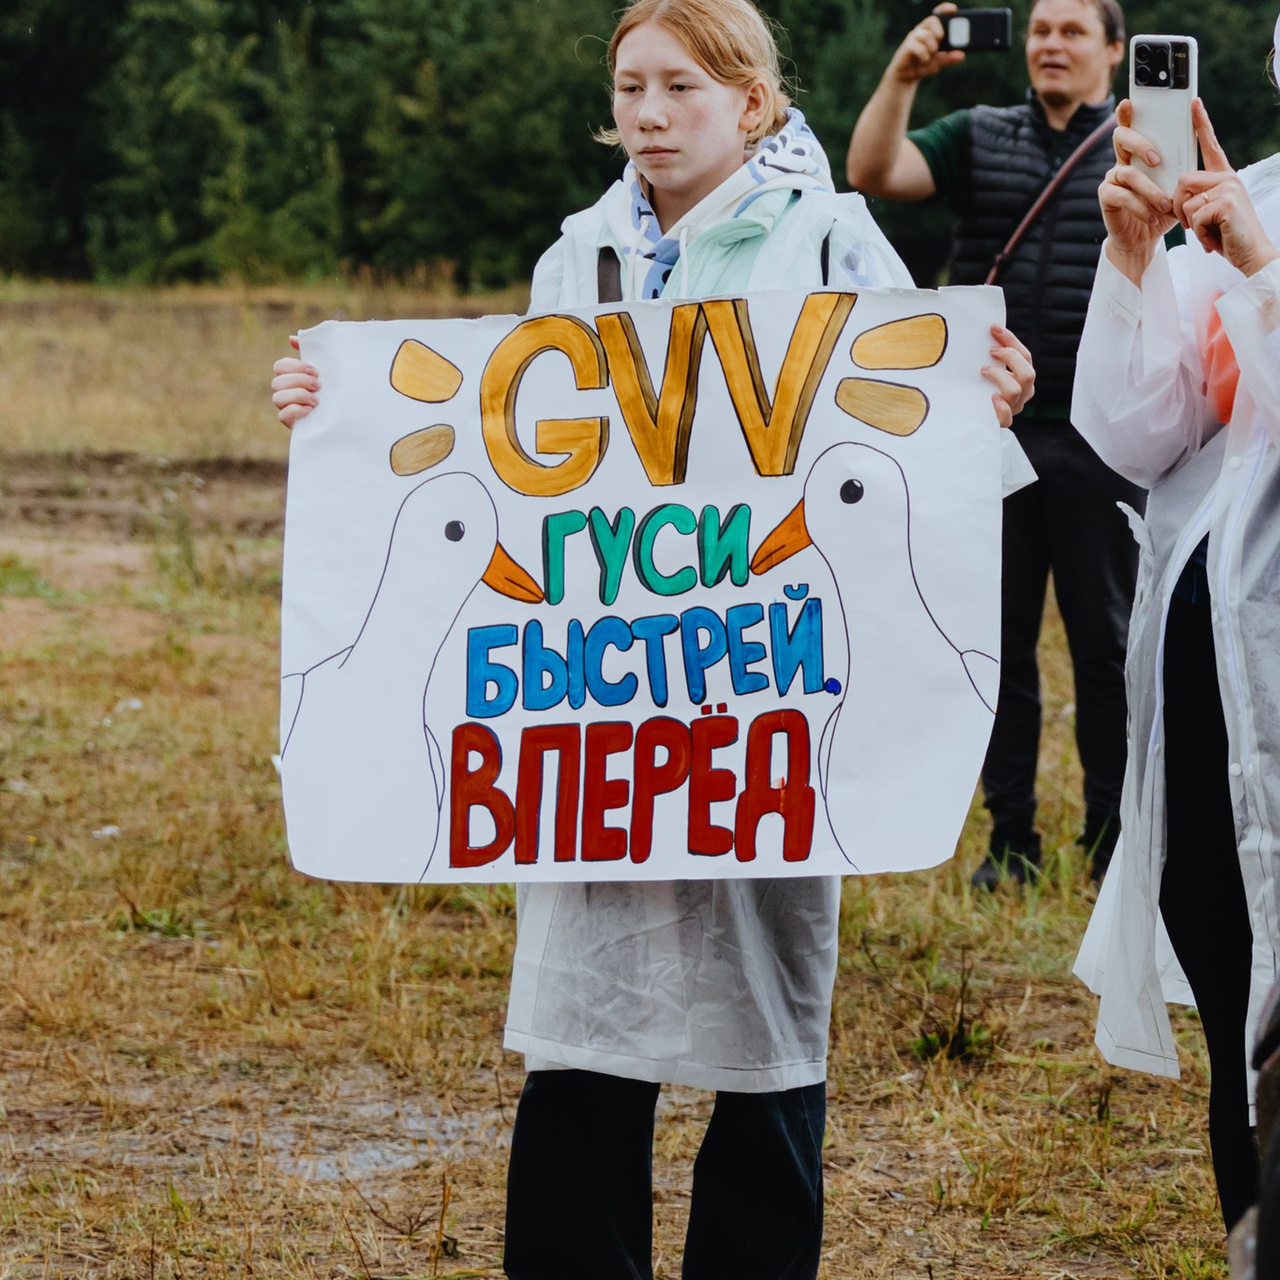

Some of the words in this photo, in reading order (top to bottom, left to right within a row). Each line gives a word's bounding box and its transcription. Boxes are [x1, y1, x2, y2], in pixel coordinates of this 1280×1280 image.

[481, 292, 857, 497] GVV
[543, 503, 752, 606] ГУСИ
[449, 703, 816, 869] ВПЕРЁД
